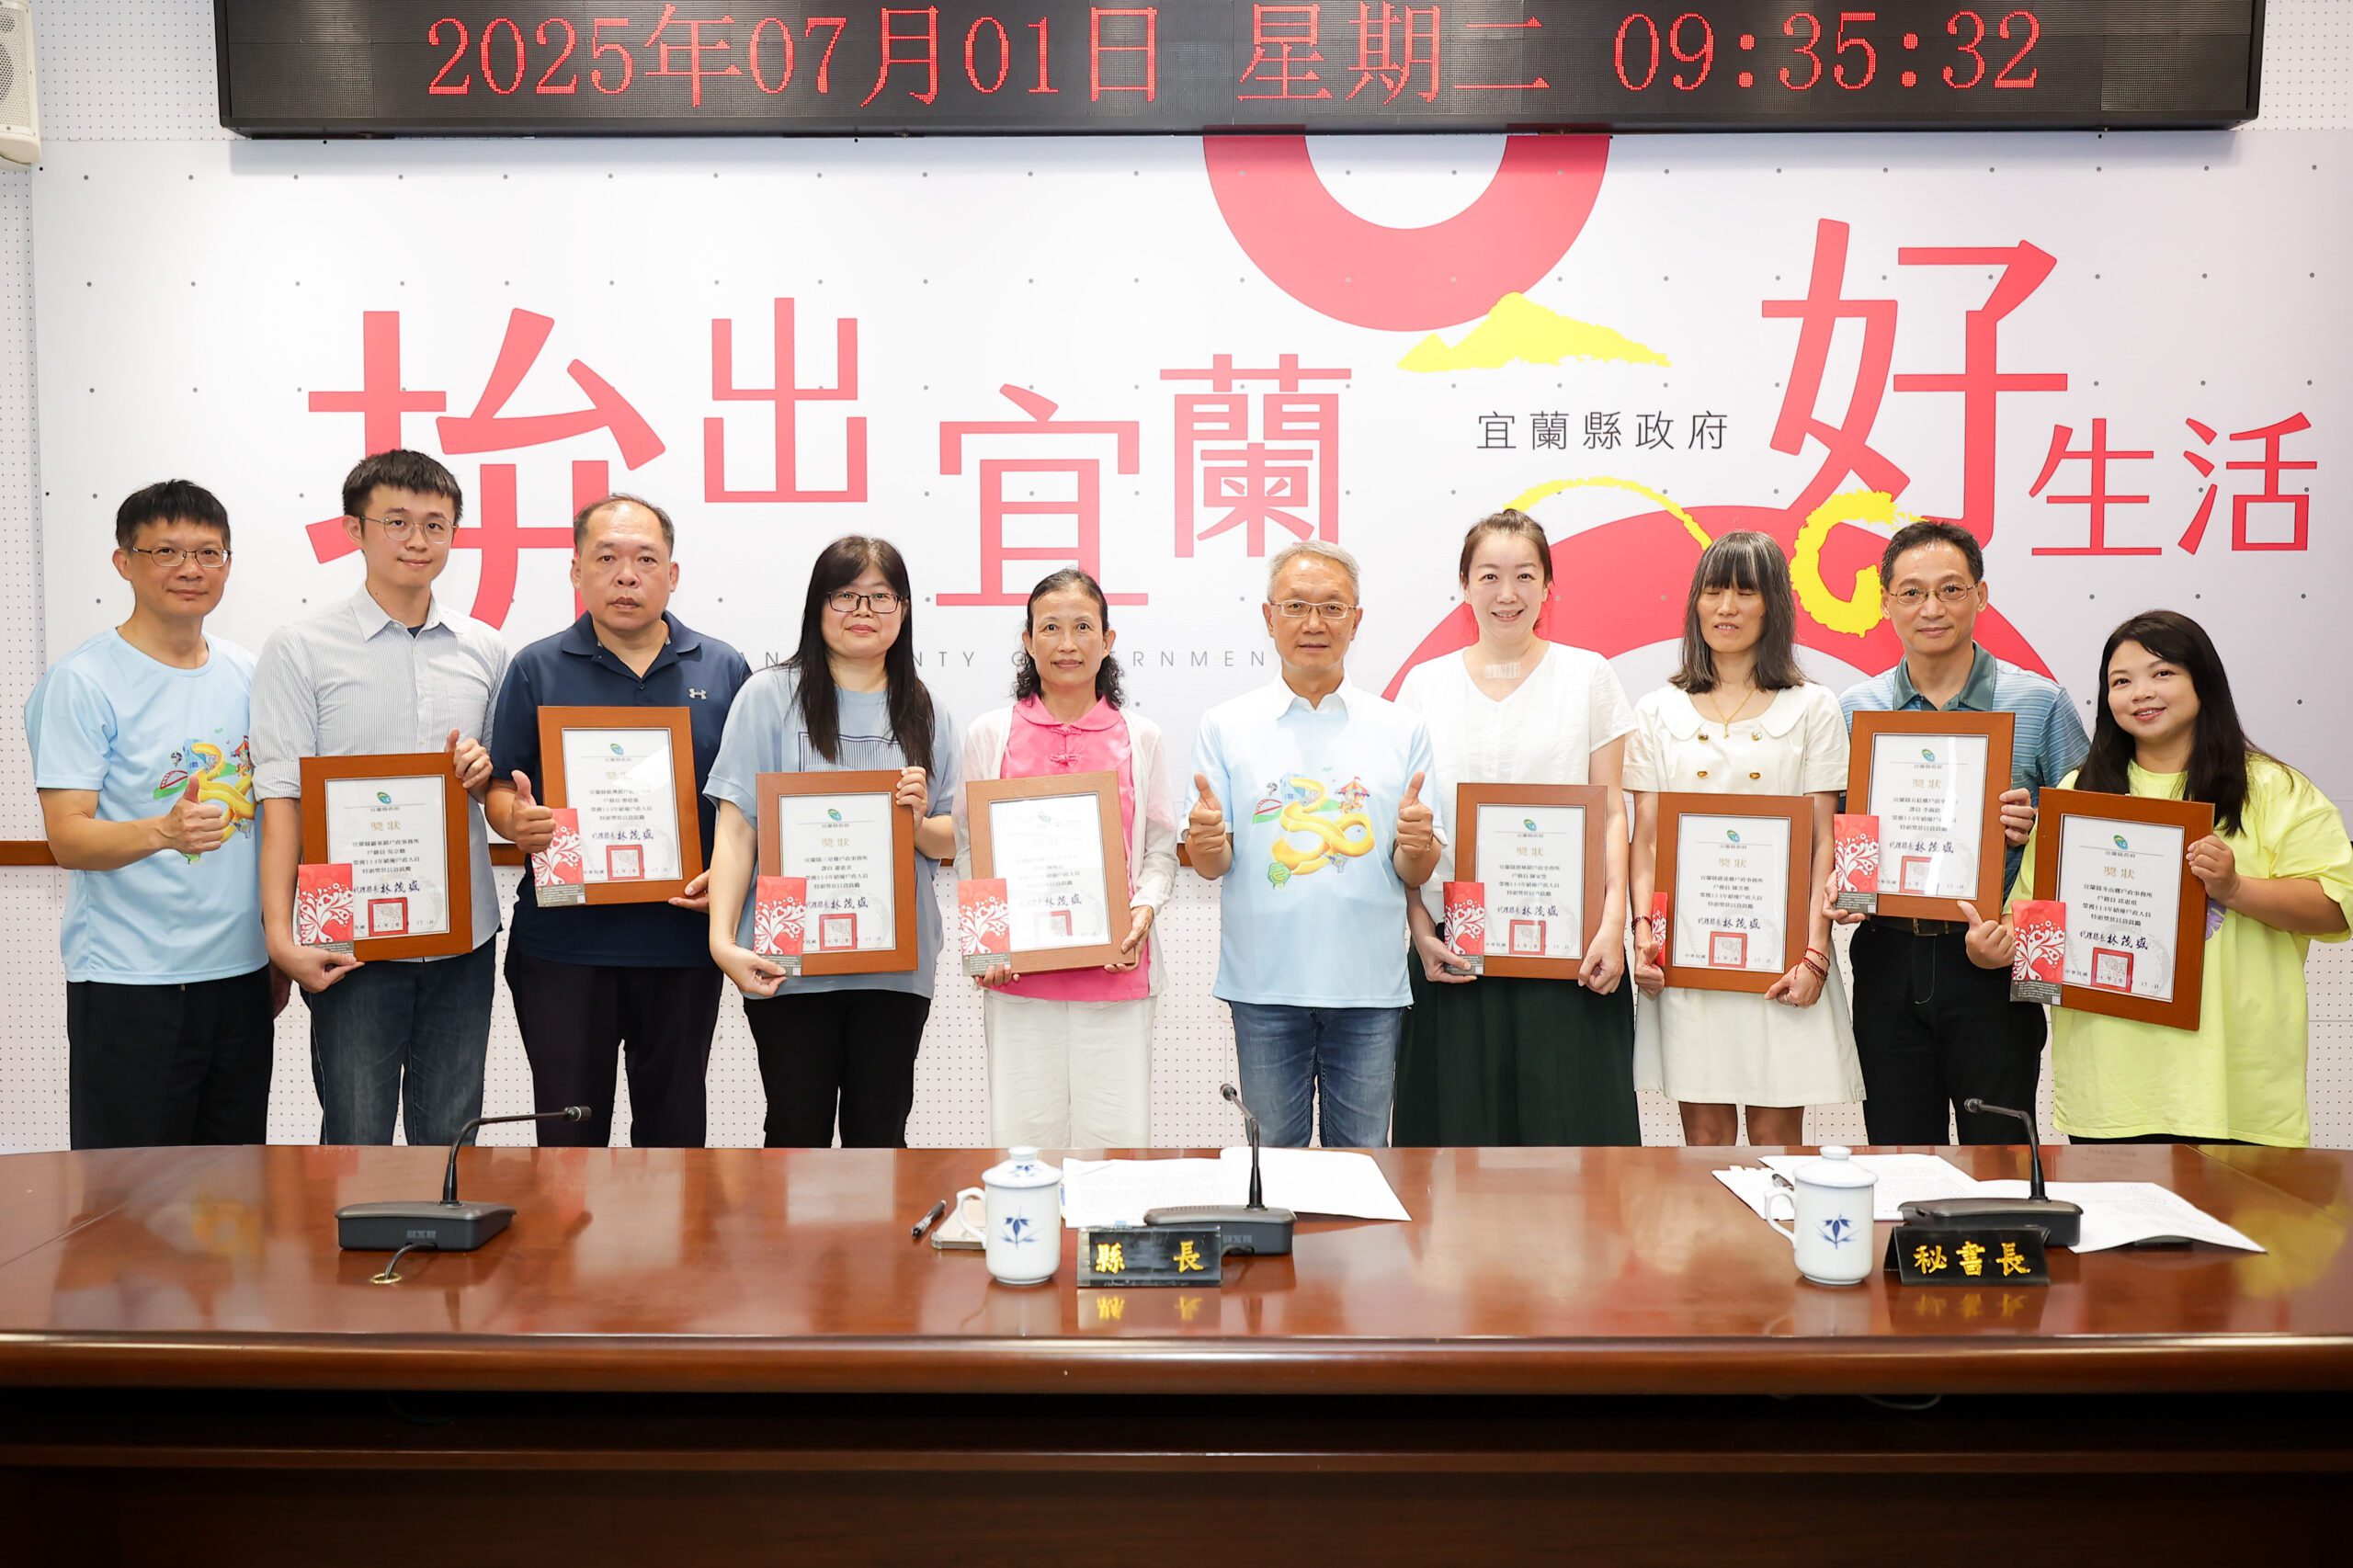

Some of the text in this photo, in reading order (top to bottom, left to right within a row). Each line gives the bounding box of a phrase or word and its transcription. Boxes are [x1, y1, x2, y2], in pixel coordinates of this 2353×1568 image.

[427, 2, 2040, 108] 2025年07月01日 星期二 09:35:32
[1477, 410, 1729, 451] 宜蘭縣政府
[2104, 866, 2135, 880] 獎狀
[1095, 1239, 1205, 1274] 縣長
[1913, 1241, 2031, 1278] 秘書長
